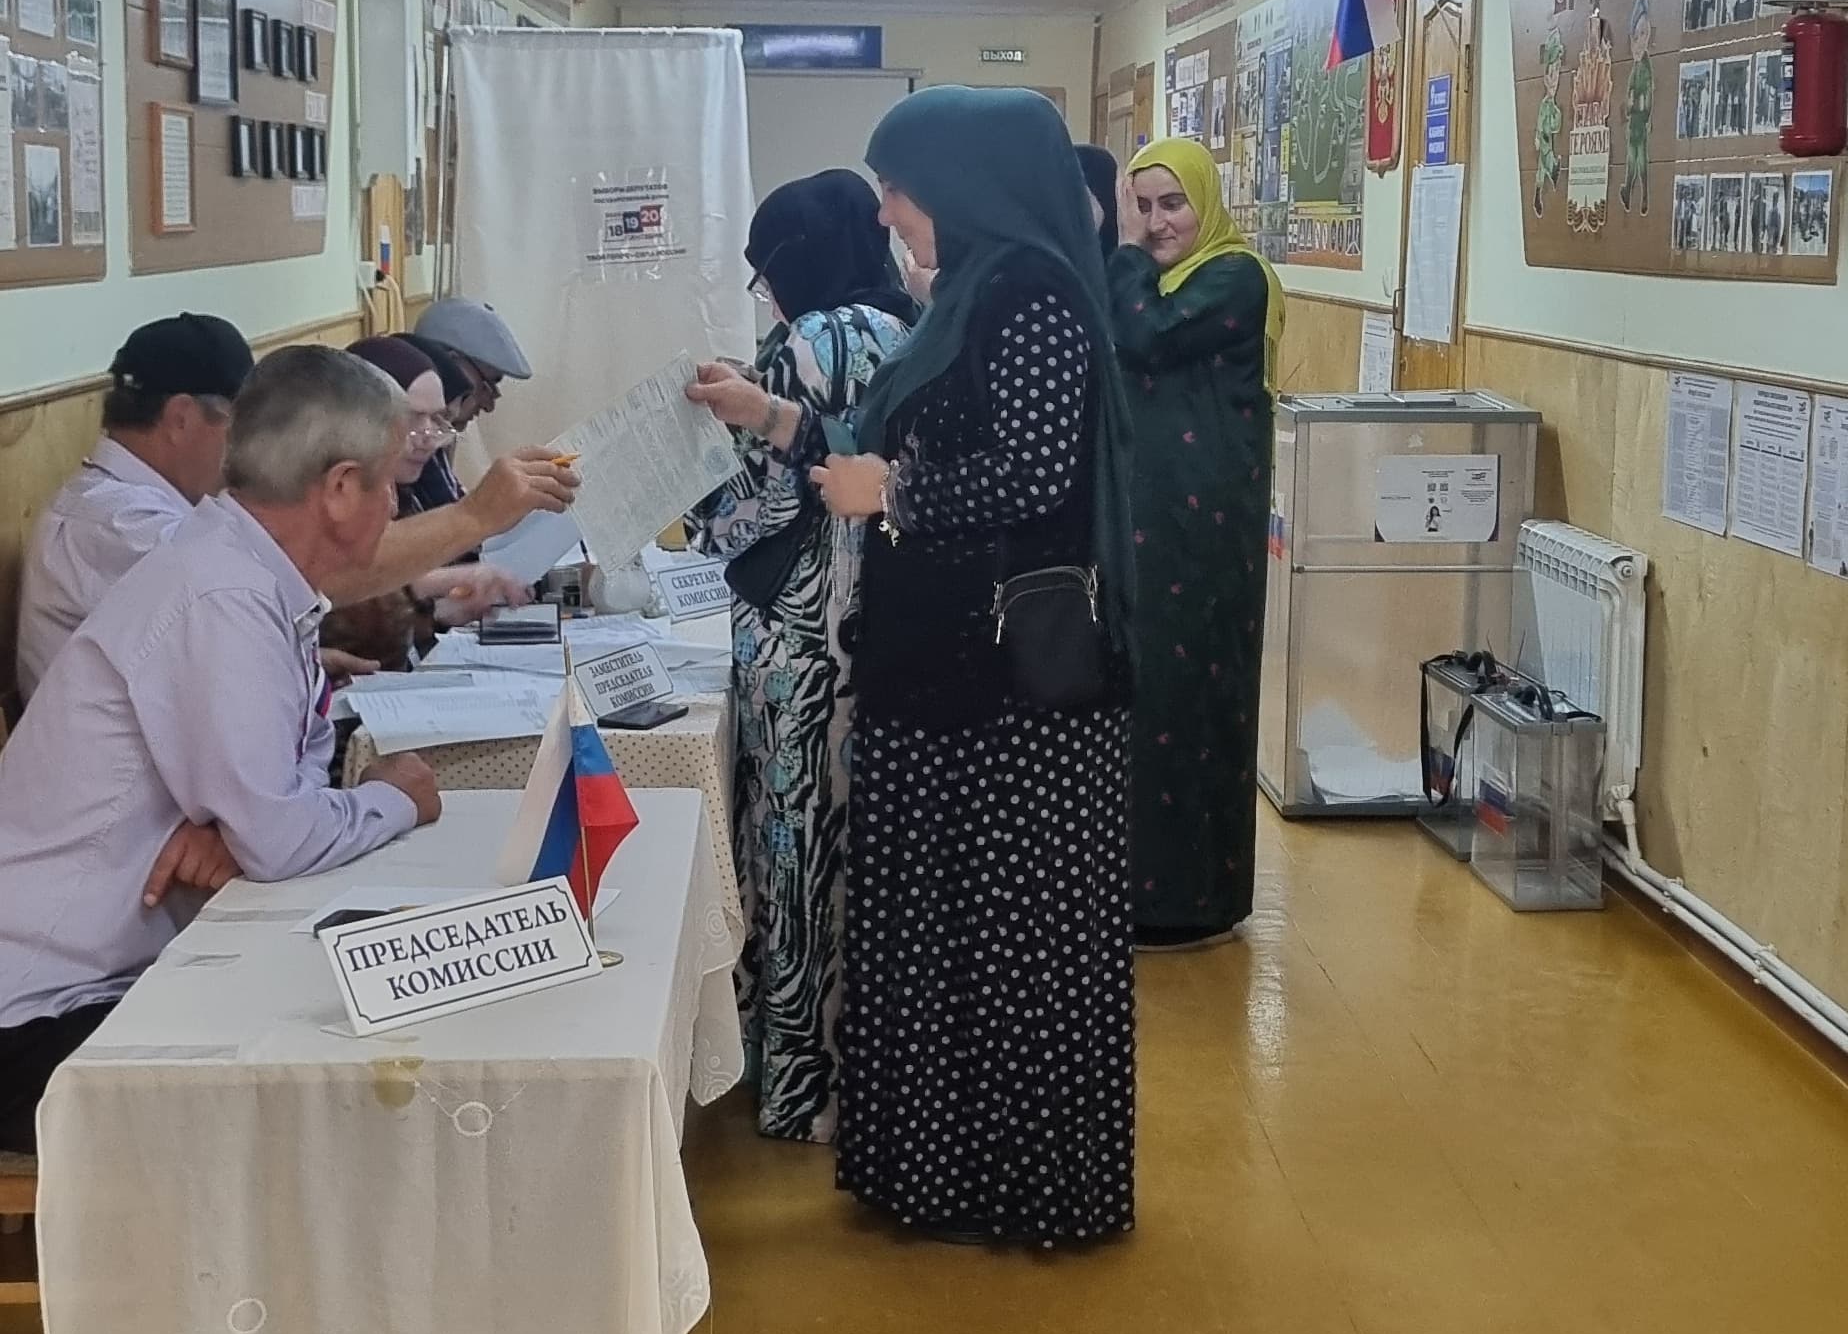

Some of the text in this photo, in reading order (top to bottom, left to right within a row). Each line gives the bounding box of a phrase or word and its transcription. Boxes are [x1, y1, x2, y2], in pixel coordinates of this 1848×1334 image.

[982, 50, 1022, 61] ВЫХОД
[608, 224, 624, 237] 18
[625, 216, 640, 229] 19
[641, 208, 660, 223] 20
[671, 570, 721, 589] СЕКРЕТАРЬ
[588, 650, 645, 679] ЗАМЕСТИТЕЛЬ
[594, 665, 655, 696] ПРЕДСЕДАТЕЛЯ
[609, 682, 656, 709] КОМИССИИ
[345, 900, 568, 972] ПРЕДСЕДАТЕЛЬ
[386, 937, 559, 1001] КОМИССИИ
